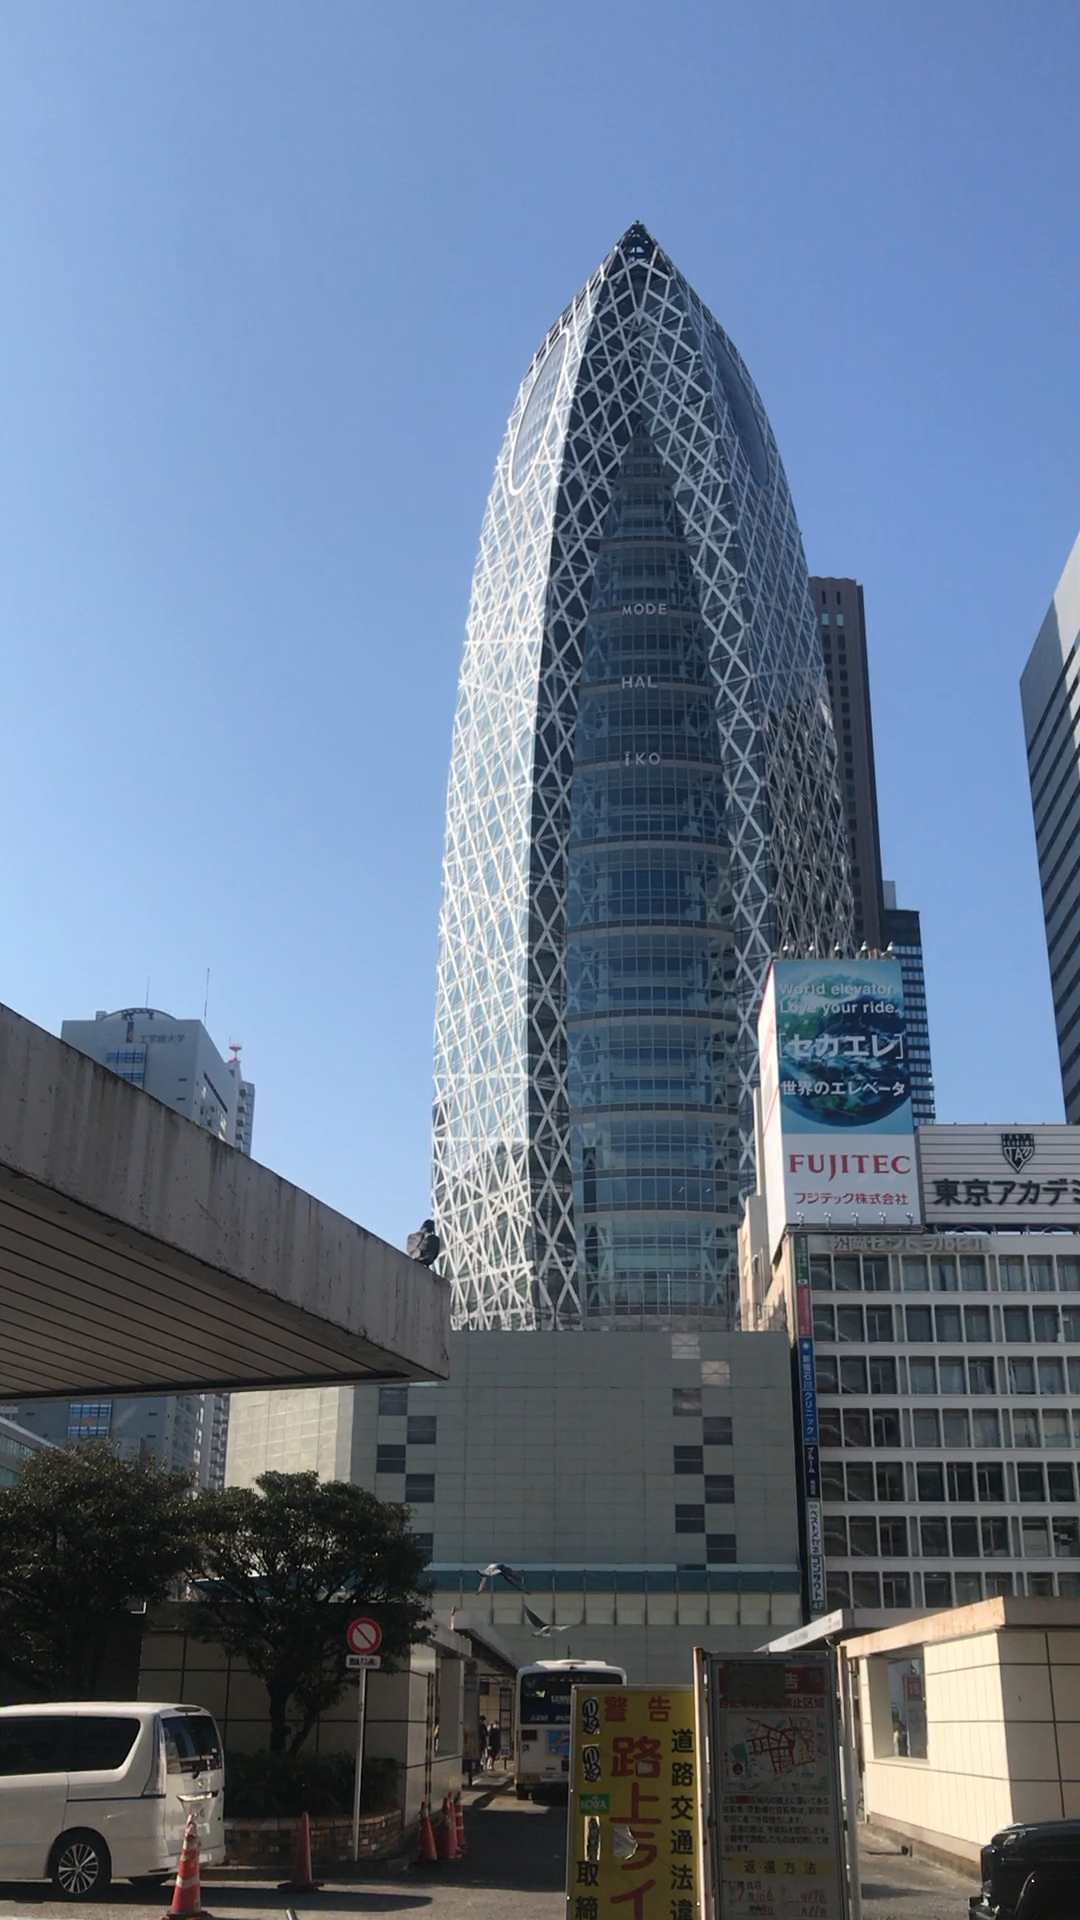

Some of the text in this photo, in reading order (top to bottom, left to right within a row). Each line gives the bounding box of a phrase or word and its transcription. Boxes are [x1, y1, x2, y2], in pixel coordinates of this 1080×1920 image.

[621, 603, 667, 615] MODE
[621, 676, 658, 689] HAL
[779, 982, 898, 995] World elevator.
[779, 1001, 899, 1015] Love your ride.
[781, 1080, 905, 1096] 世界のエレベータ
[789, 1153, 911, 1181] FUJITEC
[794, 1192, 909, 1206] フジテック株式会社
[604, 1696, 671, 1722] 警告
[575, 1861, 598, 1920] 取締
